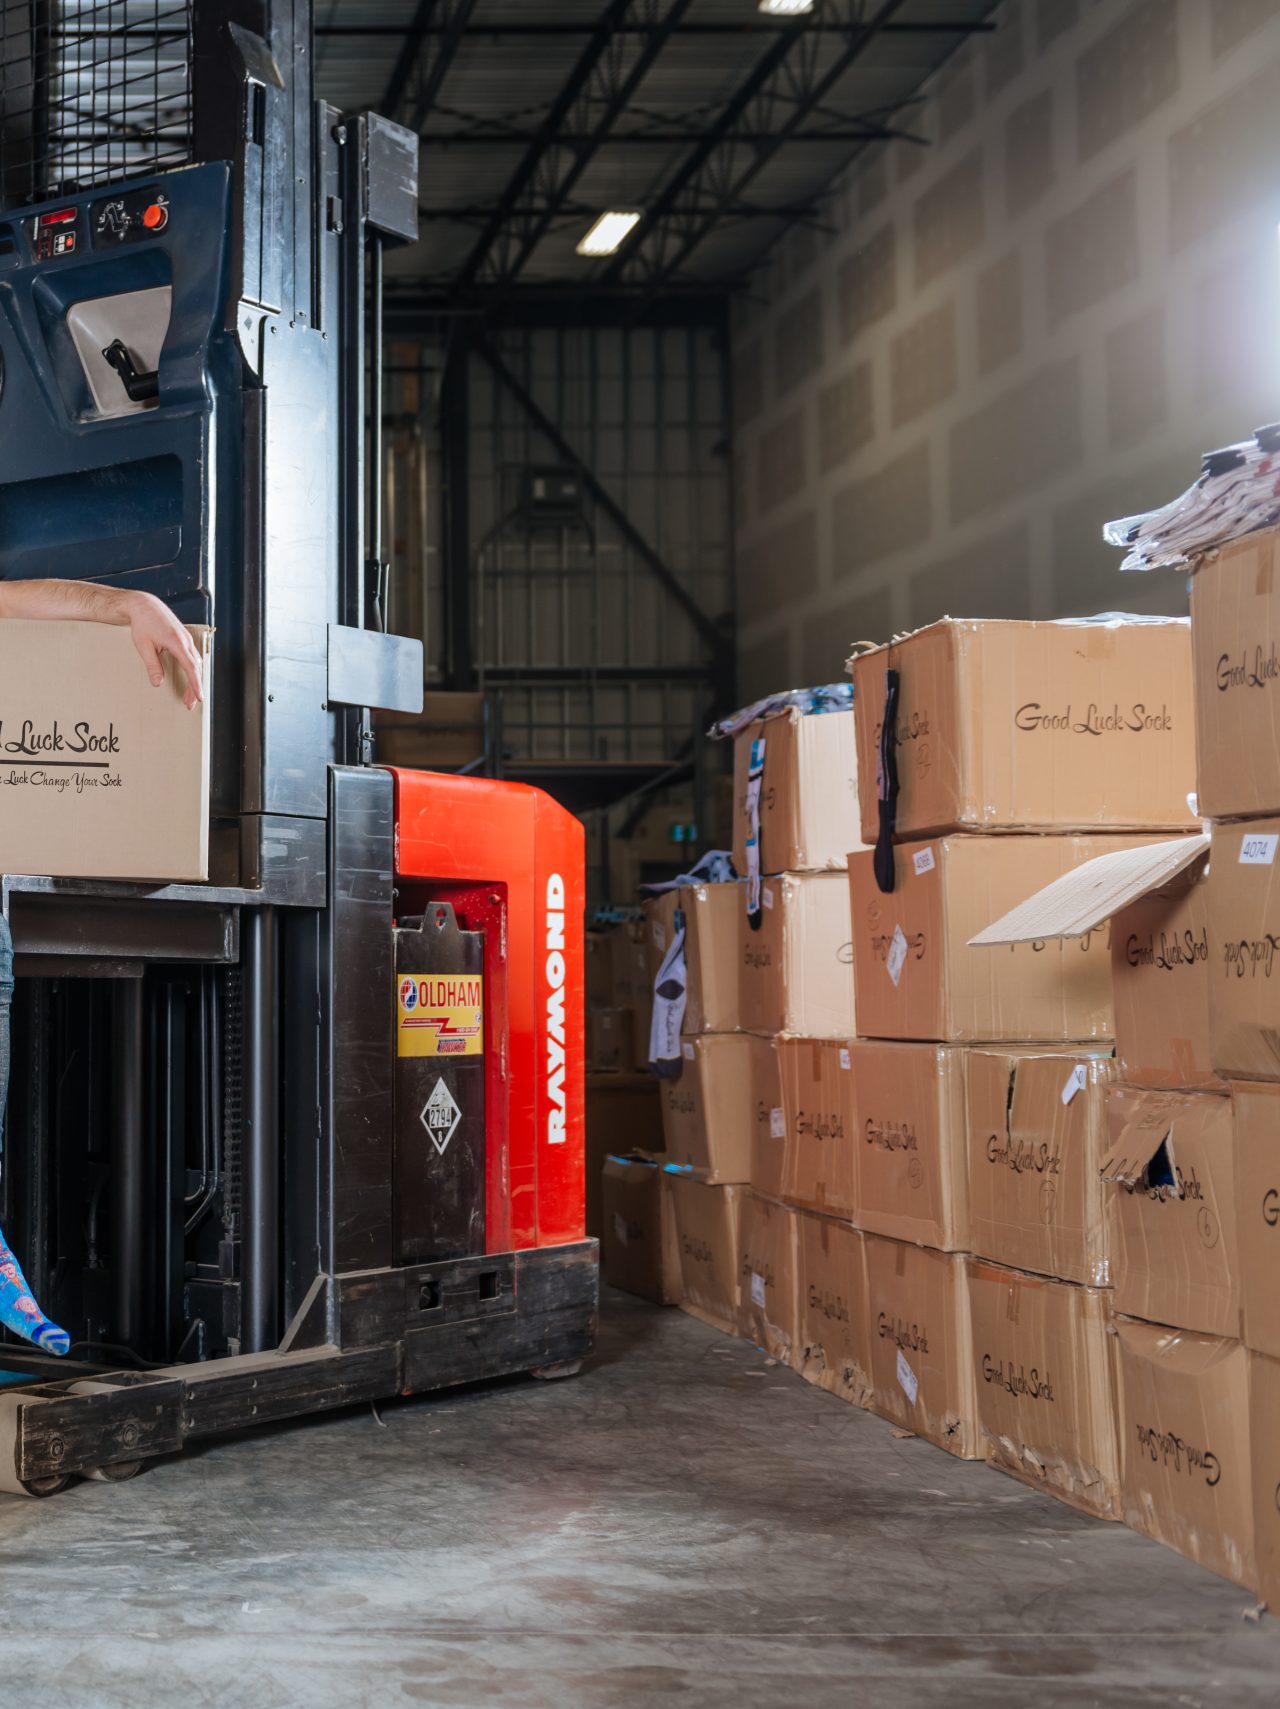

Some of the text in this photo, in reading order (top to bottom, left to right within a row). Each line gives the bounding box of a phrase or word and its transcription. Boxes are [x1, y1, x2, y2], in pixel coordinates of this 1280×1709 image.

[1216, 640, 1279, 691] Good Luck
[1014, 702, 1173, 736] Good Luck Sock
[4, 719, 64, 756] Luck
[64, 721, 120, 753] Sock
[4, 770, 28, 786] Luck
[29, 770, 70, 793] Change
[71, 772, 98, 794] Your
[99, 773, 122, 787] Sock
[1243, 841, 1269, 858] 4074
[1127, 934, 1154, 968] Good
[1156, 932, 1183, 970] Luck
[419, 981, 480, 1008] OLDHAM
[546, 873, 566, 1145] RAYMOND
[430, 1109, 452, 1127] 2794
[438, 1131, 443, 1142] 8
[1035, 1143, 1061, 1174] Sock
[982, 1354, 1054, 1402] Good Luck Sock
[1186, 1446, 1222, 1486] Good
